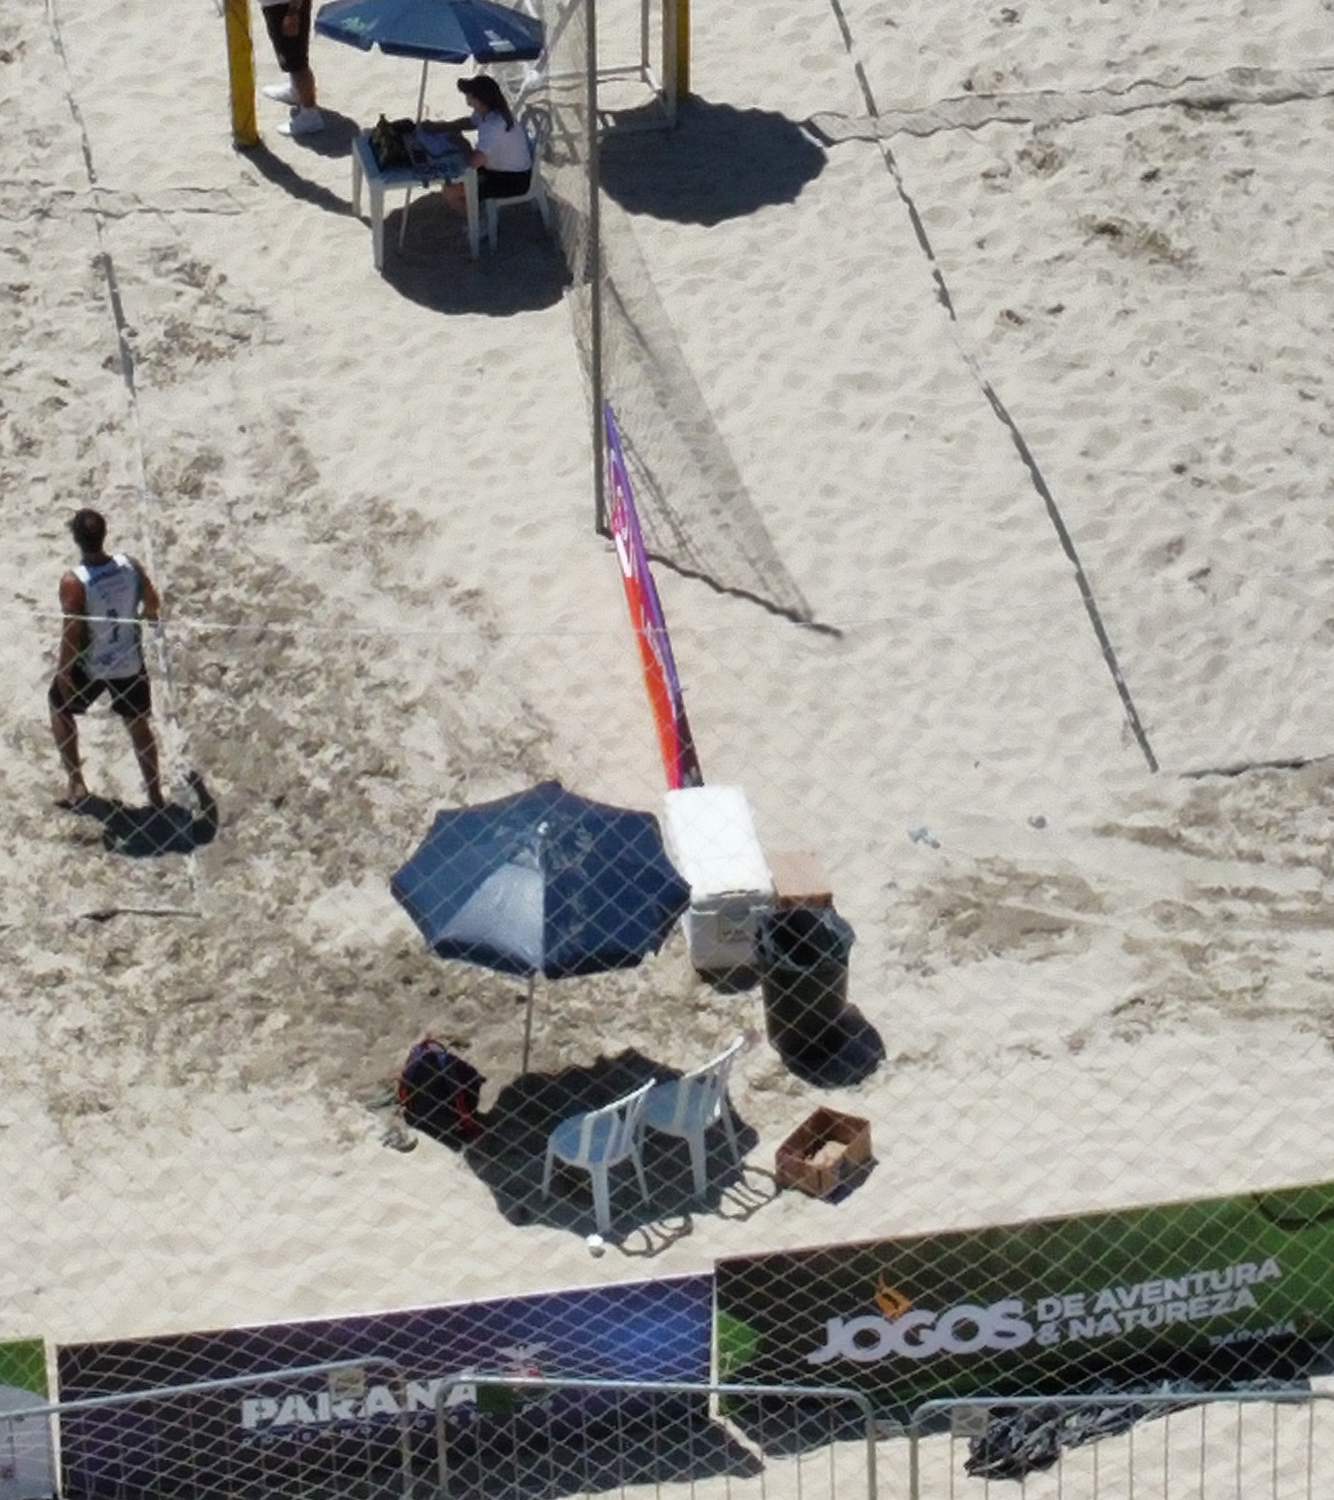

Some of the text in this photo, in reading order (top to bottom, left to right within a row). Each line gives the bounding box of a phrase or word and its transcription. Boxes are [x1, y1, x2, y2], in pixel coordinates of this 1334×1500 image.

[1036, 1288, 1259, 1347] & NATUREZA
[1037, 1258, 1282, 1323] DE AVENTURA
[805, 1298, 1035, 1364] JOGOS
